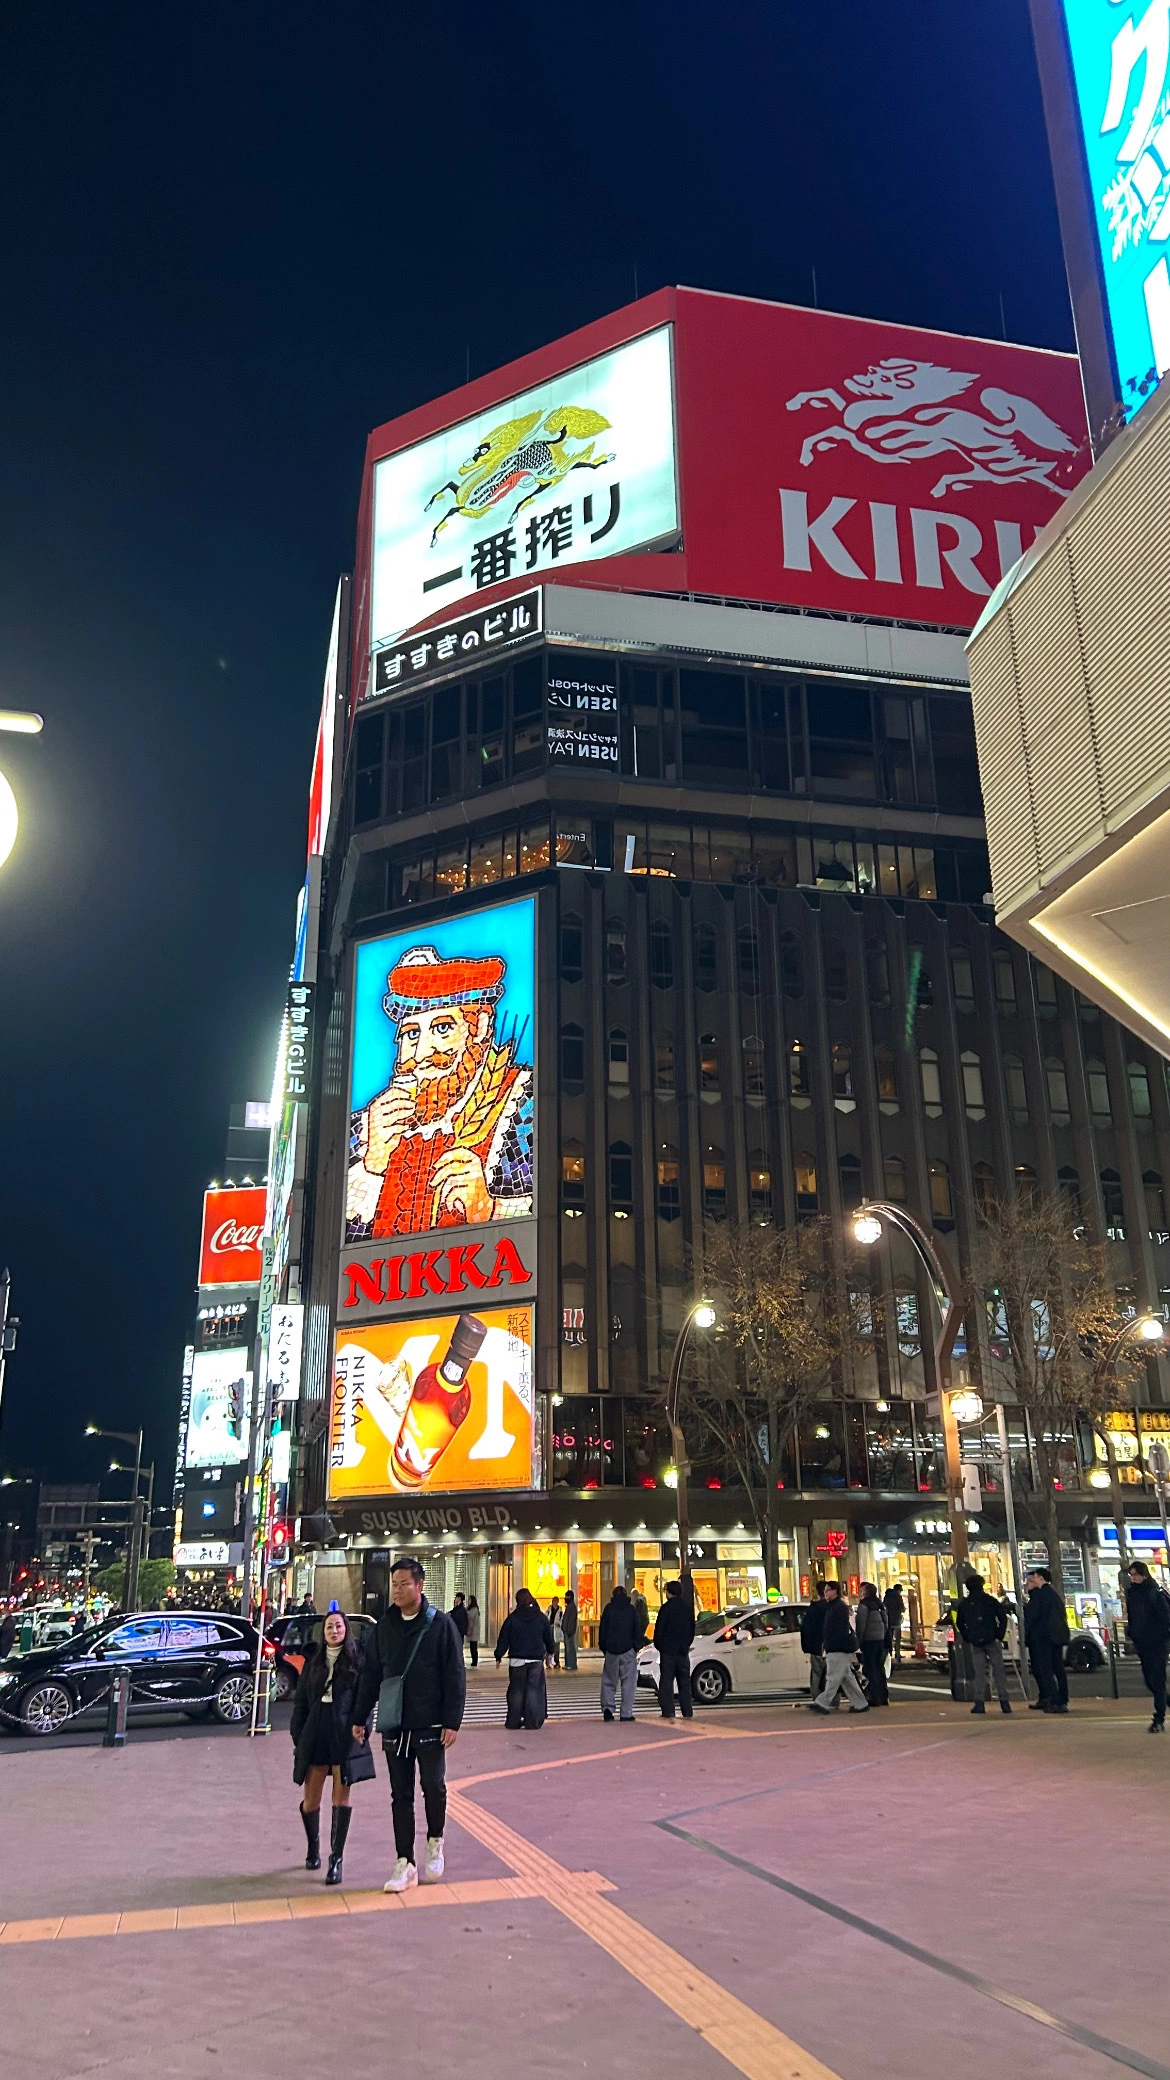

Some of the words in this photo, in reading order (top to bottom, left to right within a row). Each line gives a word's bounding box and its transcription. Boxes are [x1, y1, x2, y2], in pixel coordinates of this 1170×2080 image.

[423, 482, 620, 593] 一番搾り
[778, 488, 1044, 596] KIRI
[384, 605, 531, 680] すすきのビル
[286, 986, 311, 1094] すすきのビル
[343, 1237, 533, 1308] NIKKA
[331, 1357, 349, 1467] FRONTIER
[350, 1355, 366, 1428] NIKKA
[361, 1507, 463, 1532] SUSUKINO
[468, 1505, 518, 1527] BLD.
